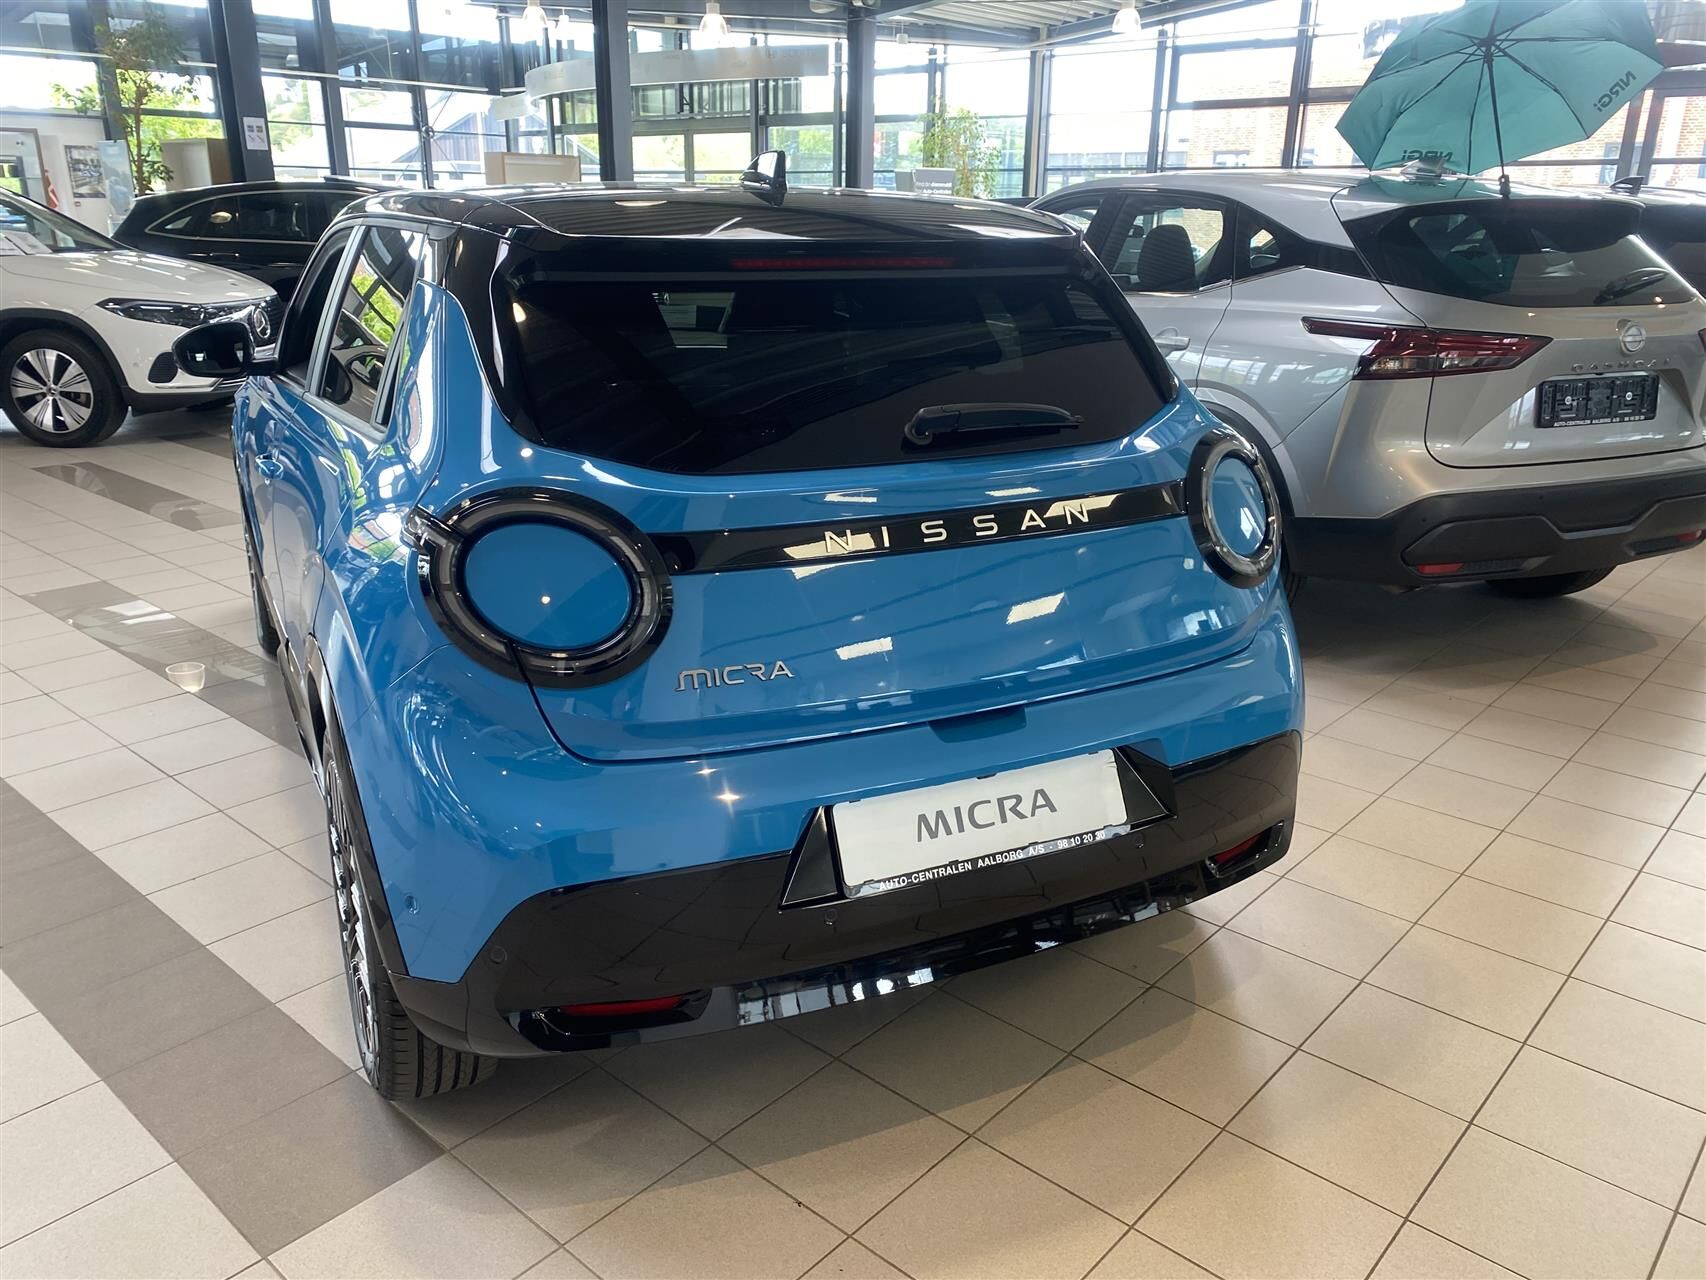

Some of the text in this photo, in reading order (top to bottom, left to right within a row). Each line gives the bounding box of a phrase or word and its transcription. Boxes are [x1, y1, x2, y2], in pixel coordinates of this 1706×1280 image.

[823, 502, 1090, 554] NISSAN
[675, 660, 797, 693] MICRA
[916, 788, 1058, 843] MICRA
[879, 862, 972, 891] AUTO-CENTRALEN
[977, 850, 1023, 869] AALBORG
[1028, 844, 1045, 856] A/S
[1057, 840, 1069, 849] 98
[1071, 836, 1081, 847] 10
[1083, 833, 1093, 843] 20
